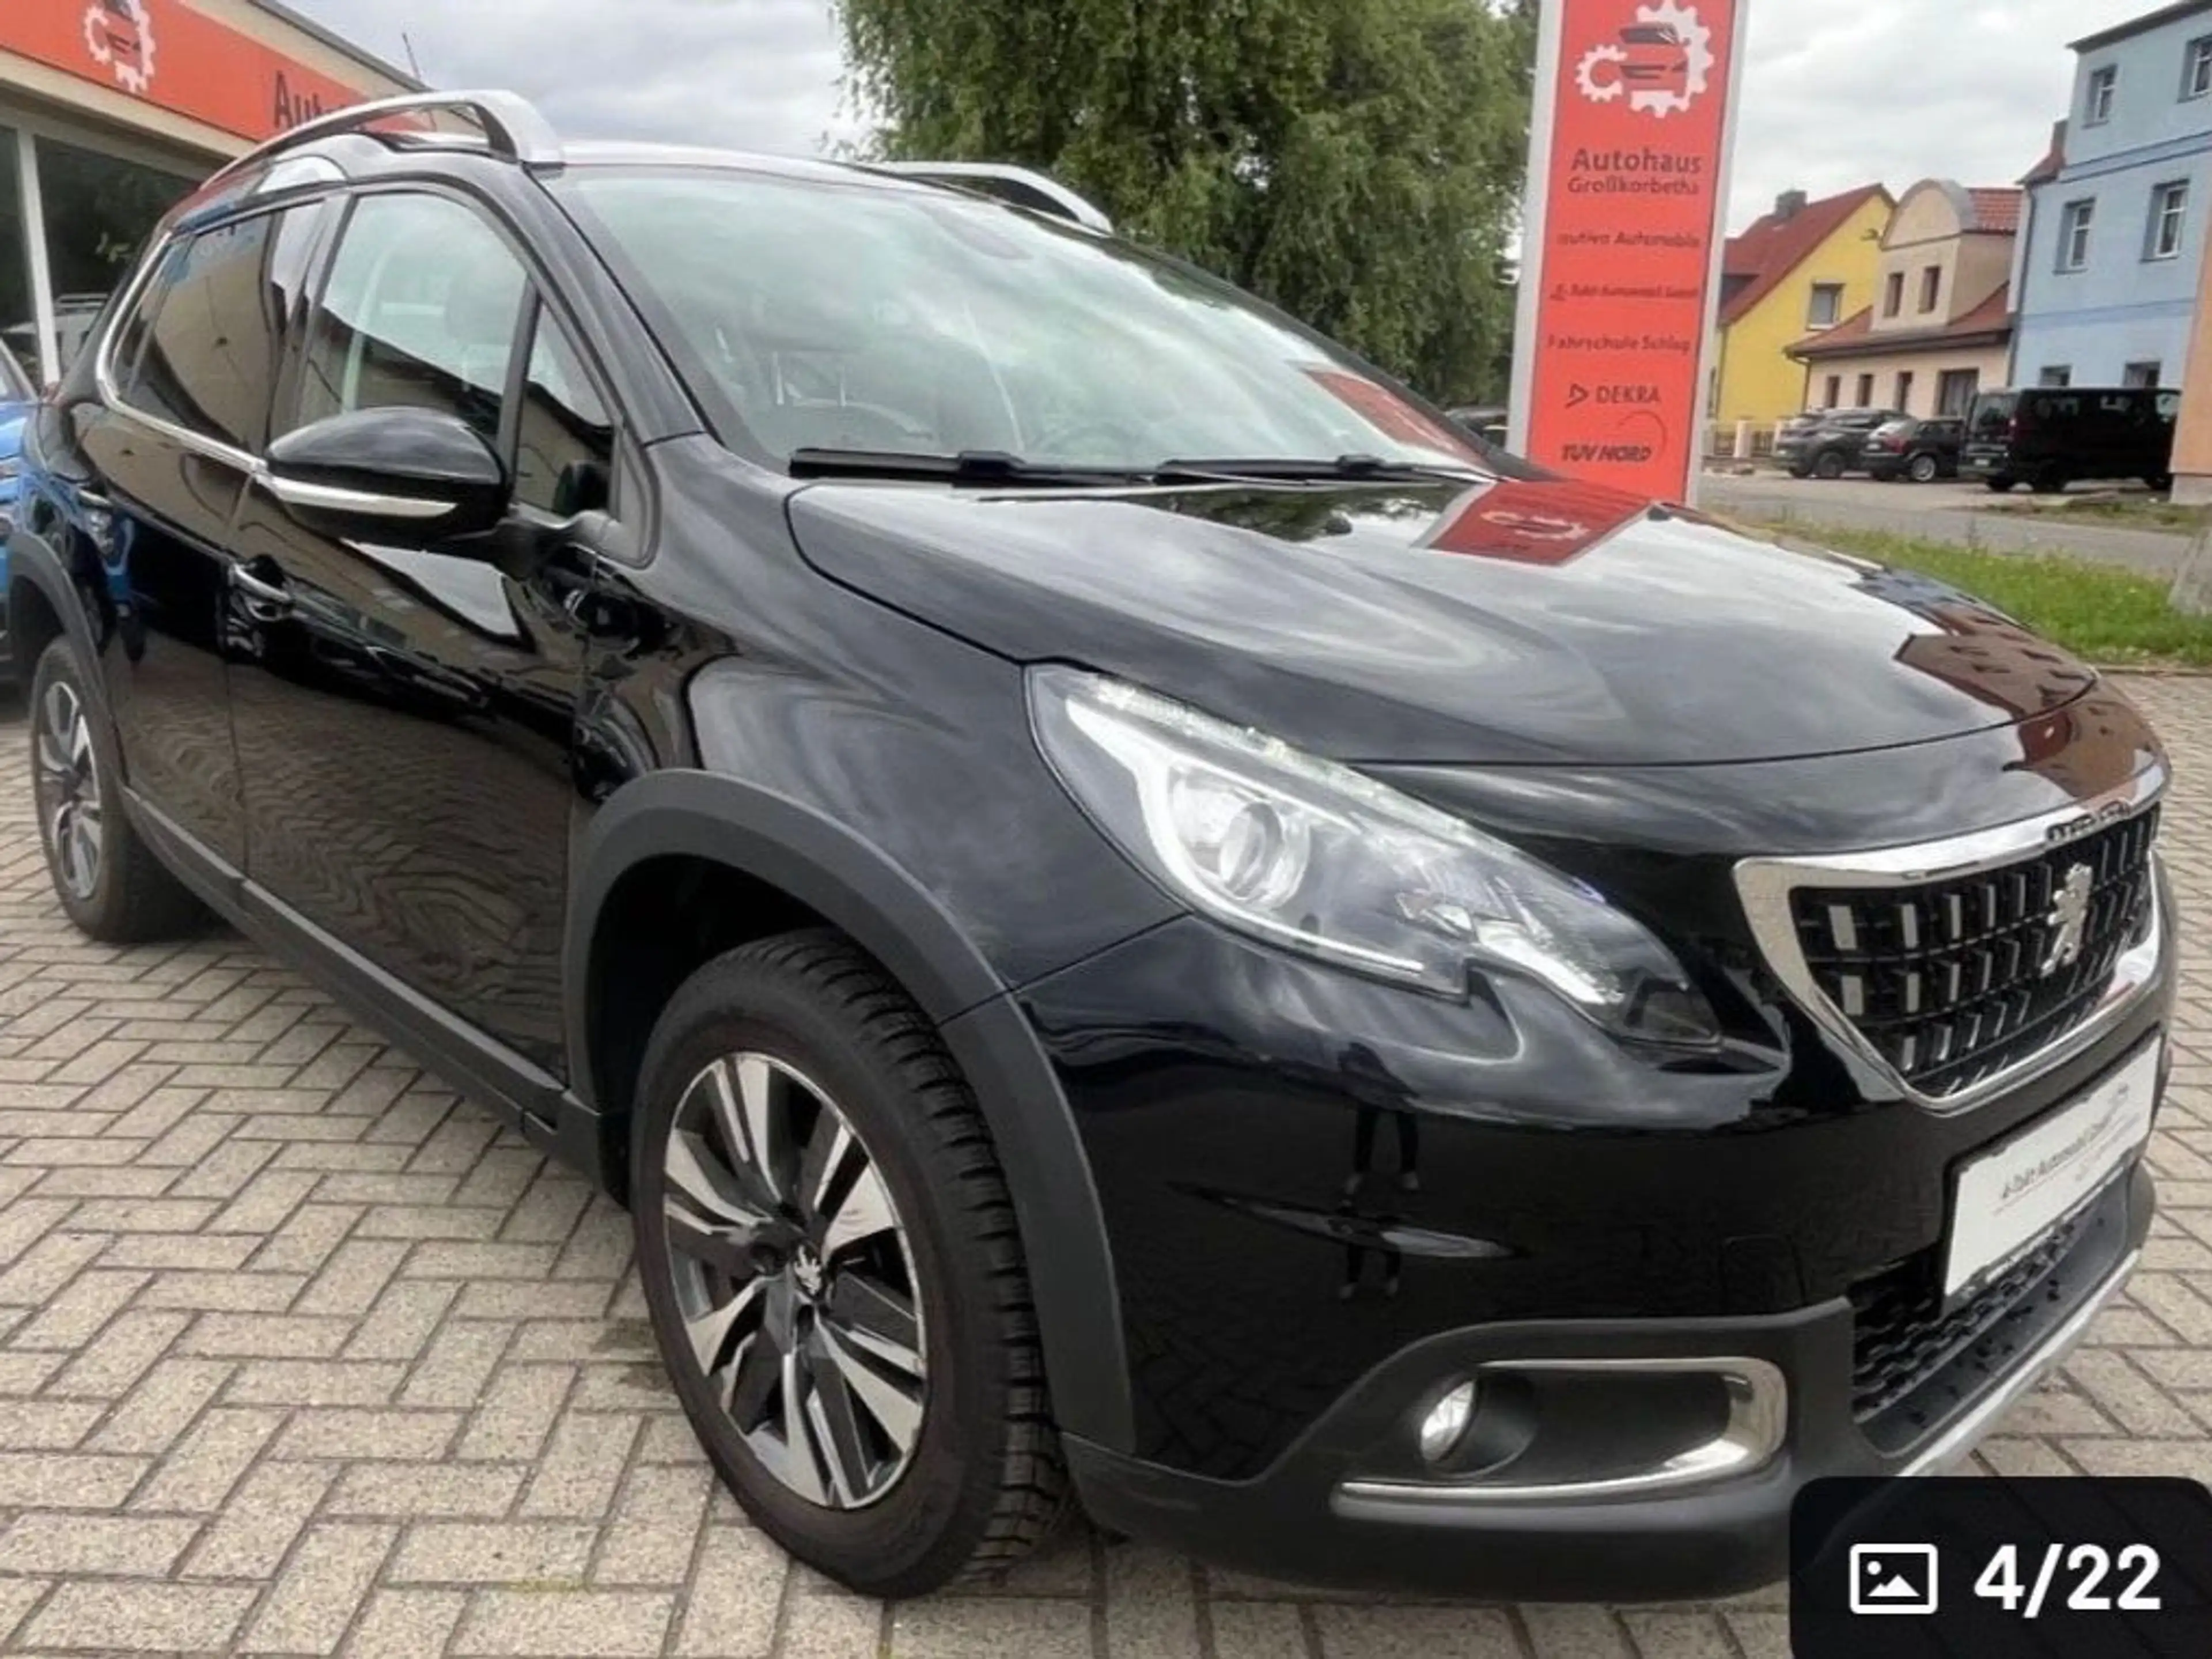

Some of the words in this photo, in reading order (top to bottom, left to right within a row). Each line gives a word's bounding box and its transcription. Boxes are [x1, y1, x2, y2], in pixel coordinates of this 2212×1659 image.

[1571, 147, 1702, 173] Autohaus
[1596, 385, 1661, 404] DEKRA
[1598, 444, 1652, 461] NORD
